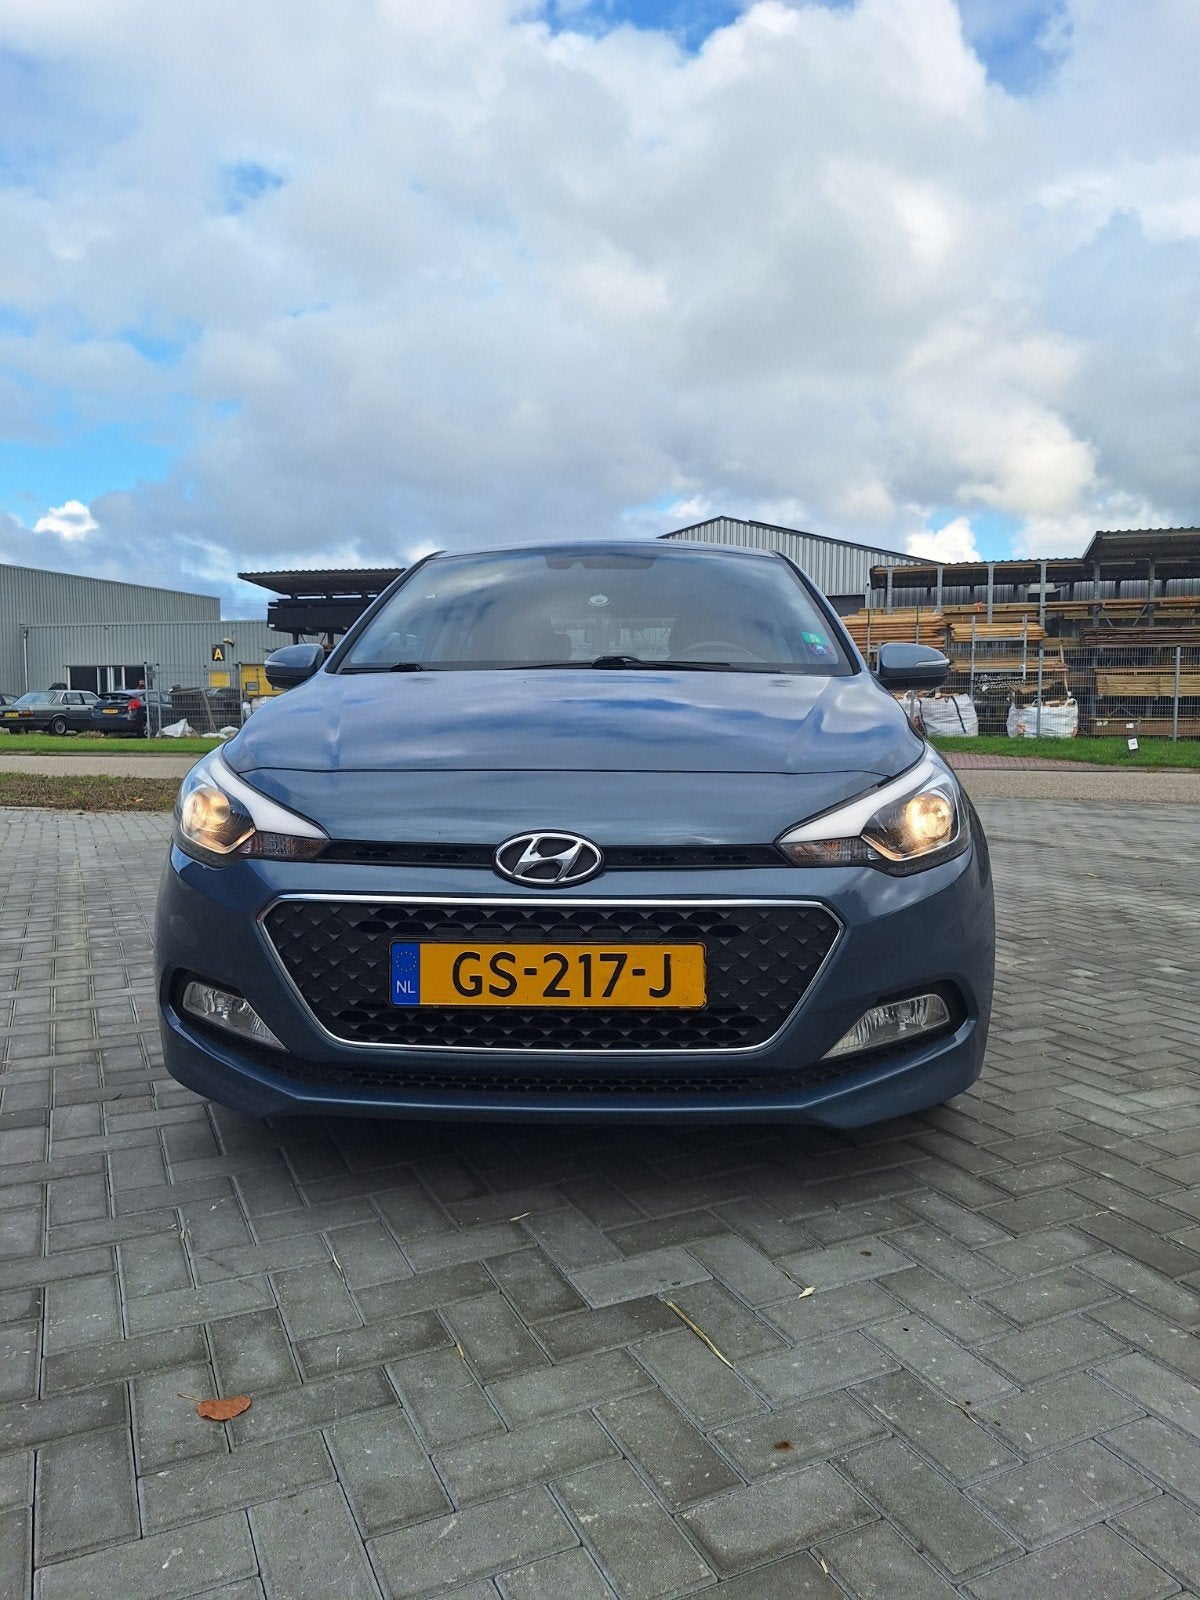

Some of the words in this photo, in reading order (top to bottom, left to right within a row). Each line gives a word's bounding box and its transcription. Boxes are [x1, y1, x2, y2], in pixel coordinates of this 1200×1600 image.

[214, 648, 223, 660] A
[452, 951, 672, 998] GS-217-J
[396, 980, 416, 994] NL
